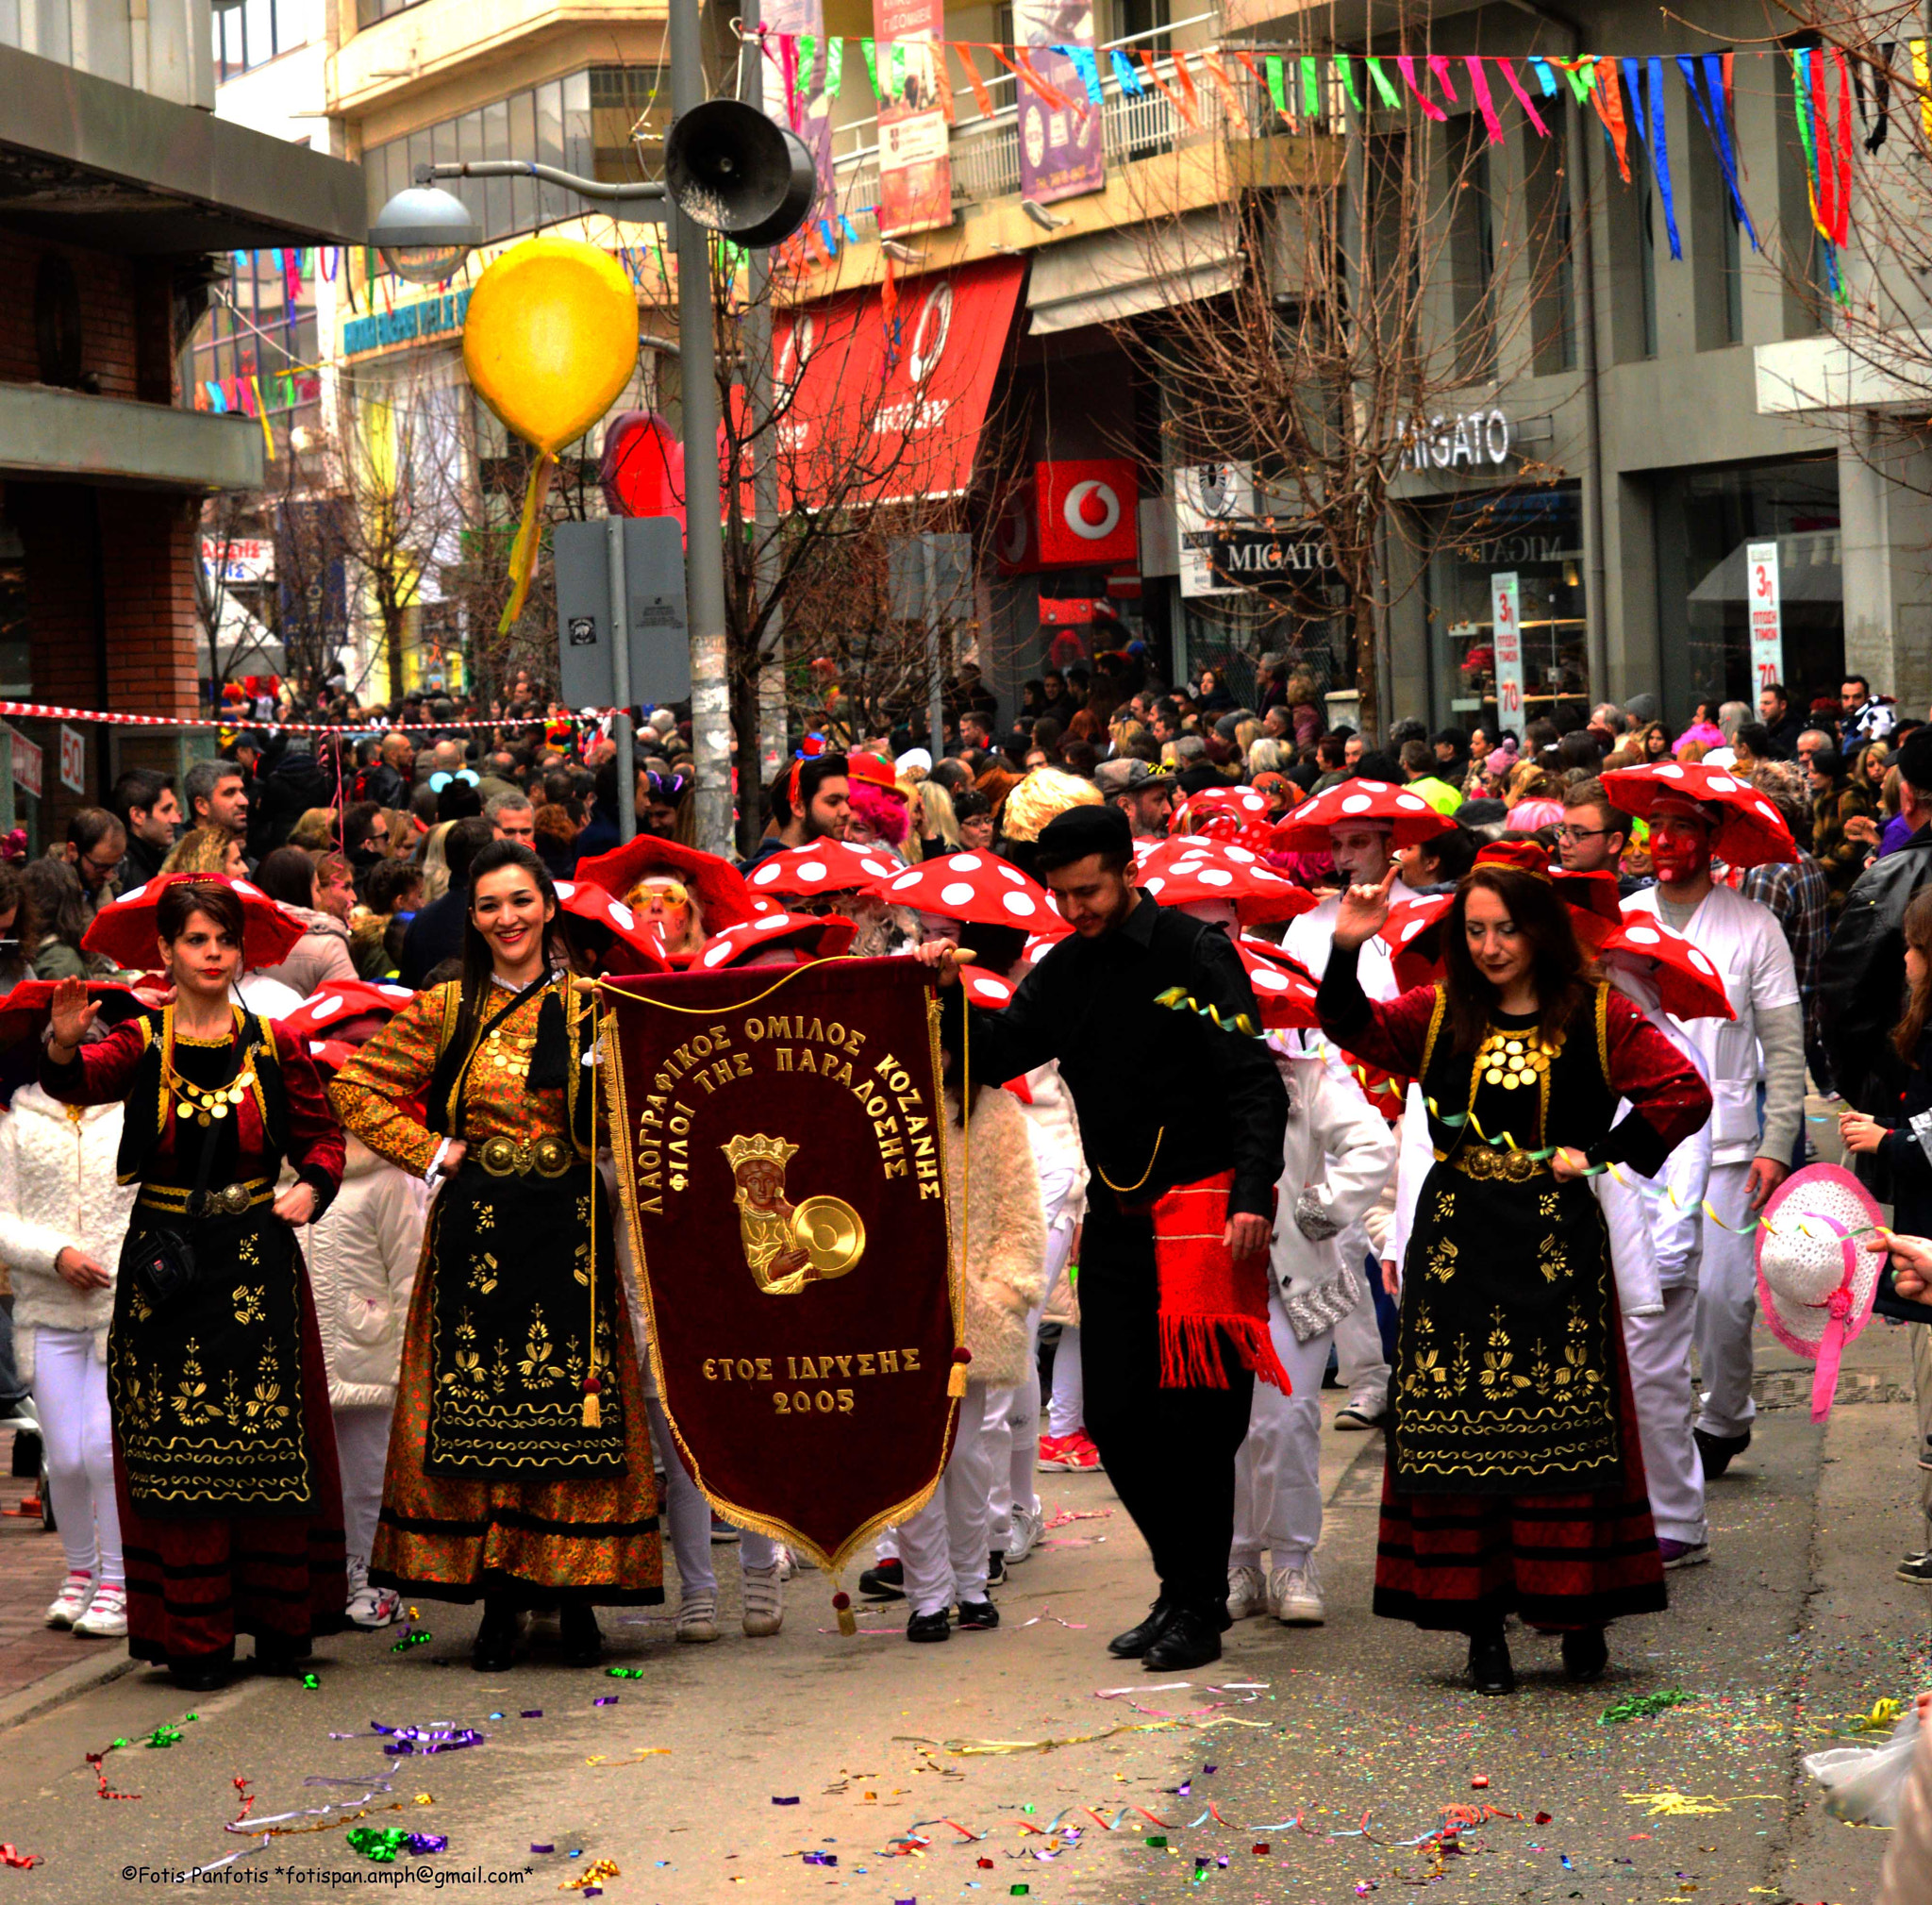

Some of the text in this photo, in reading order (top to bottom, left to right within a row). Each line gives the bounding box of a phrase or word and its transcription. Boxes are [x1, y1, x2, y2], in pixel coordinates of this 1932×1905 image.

[1397, 409, 1508, 471] MIGATO
[1227, 542, 1338, 572] MIGATO
[1501, 683, 1519, 711] 70
[62, 732, 81, 785] 50
[638, 1016, 941, 1215] ΛΑΟΓΡΑΦΙΚΟΣ ΟΜΙΛΟΣ ΚΟΖΑΝΗΣ
[669, 1101, 696, 1192] ΦΙΛΟΙ
[693, 1053, 753, 1095] ΤΗΣ
[787, 1348, 921, 1379] ΙΔΡΥΣΗΣ
[773, 1389, 855, 1414] 2005
